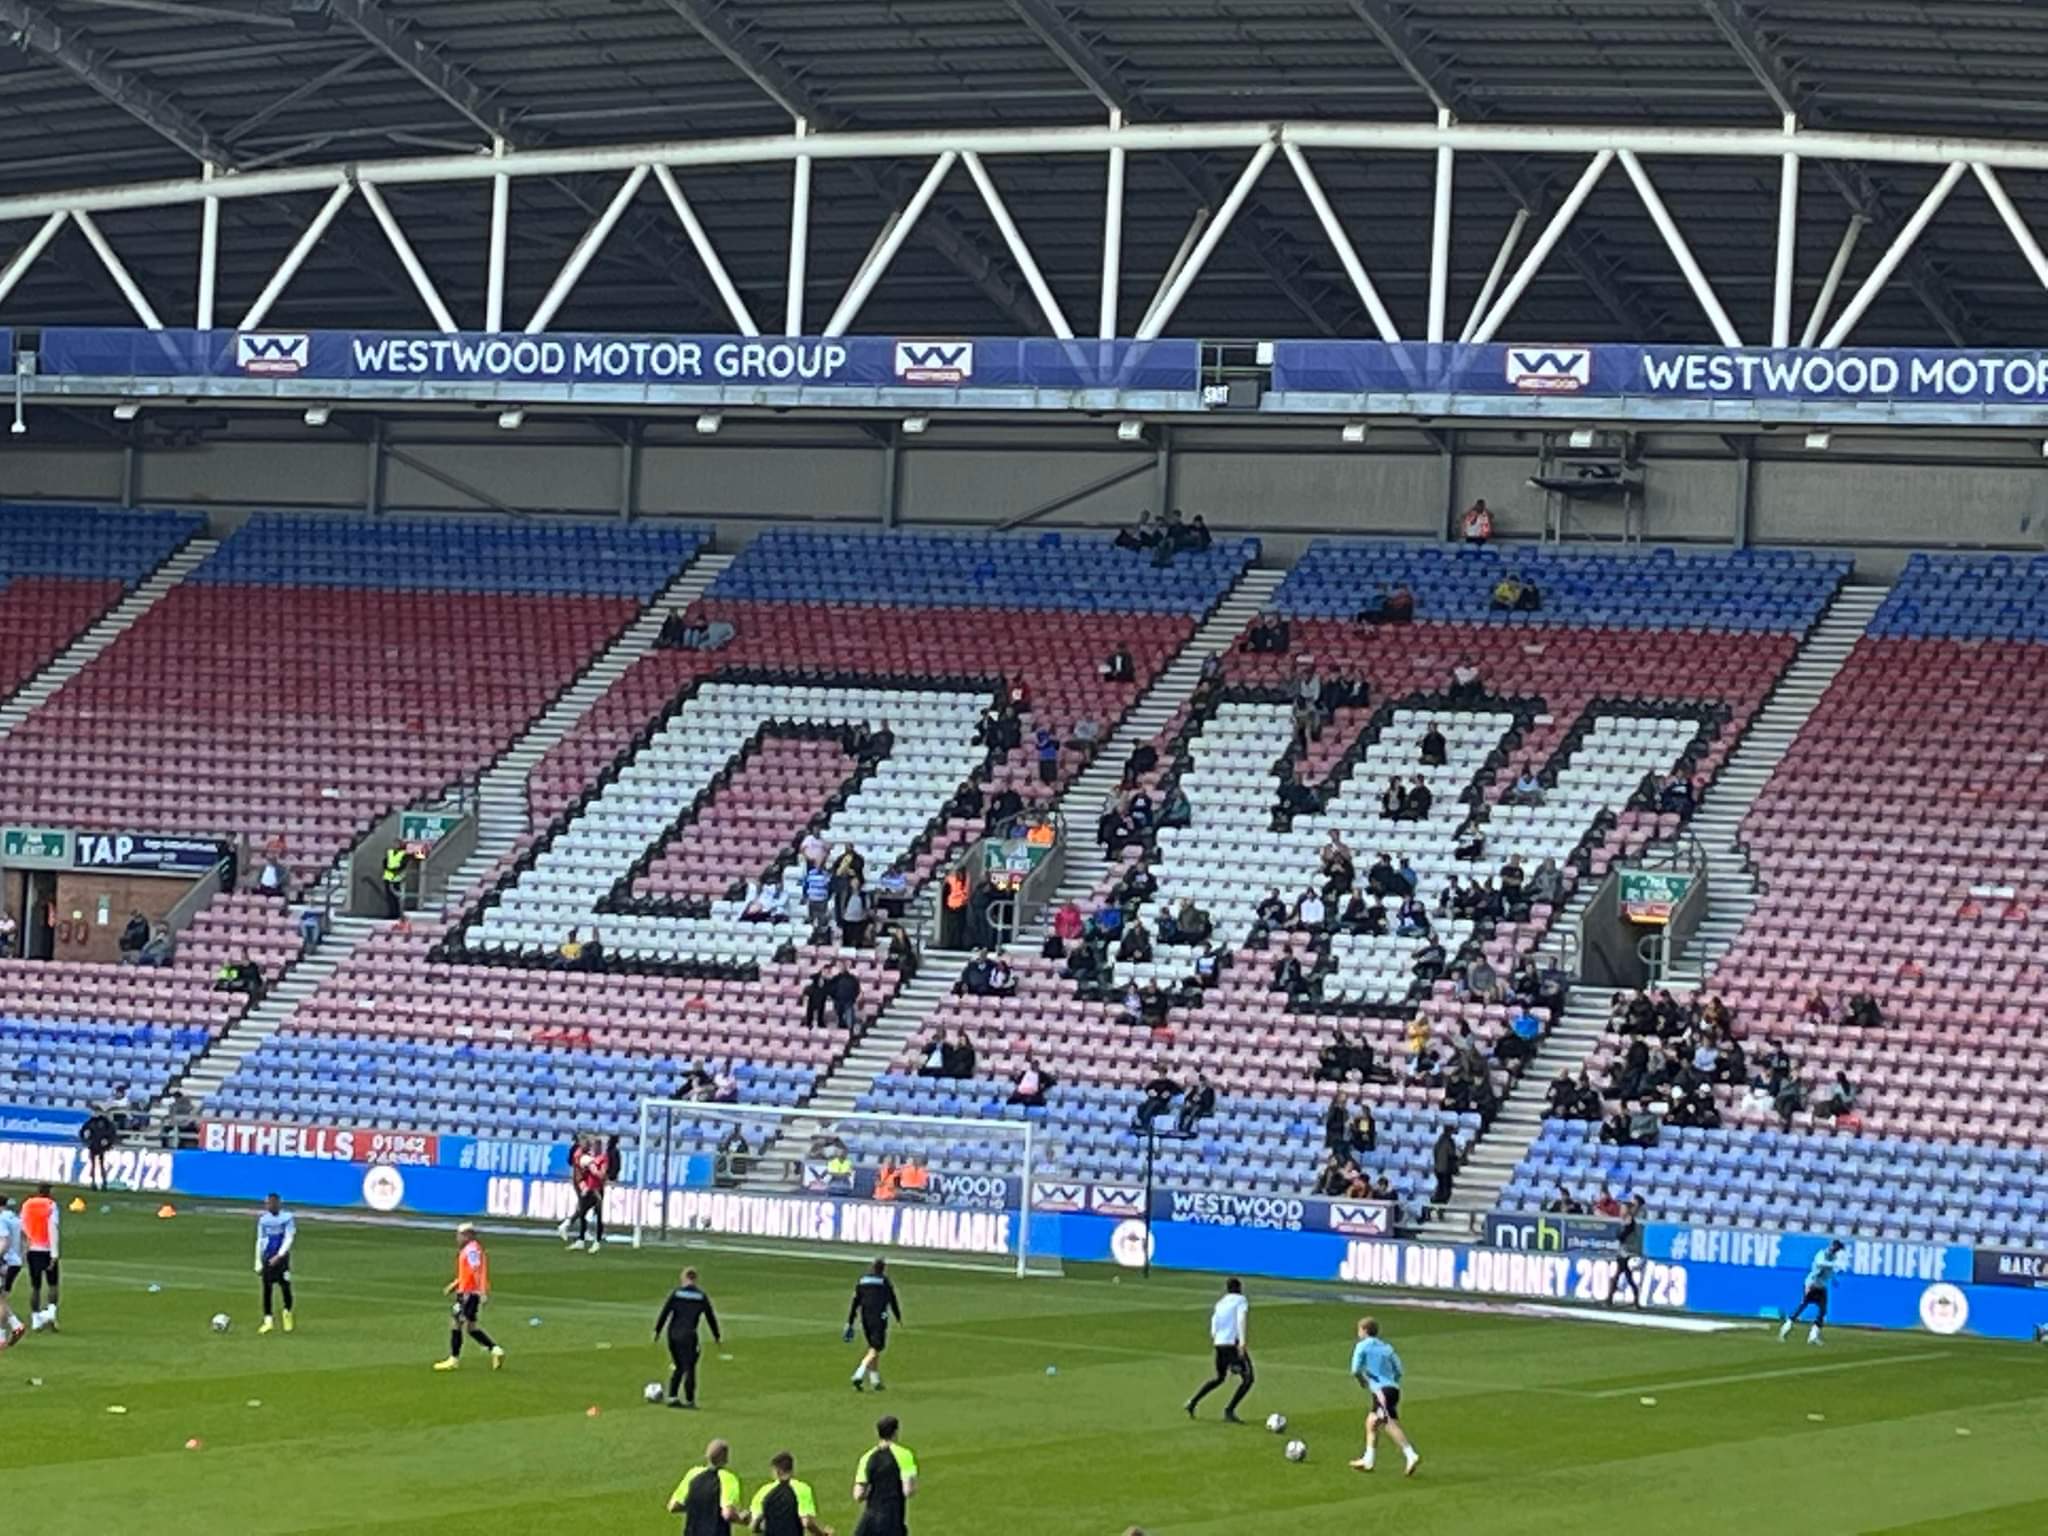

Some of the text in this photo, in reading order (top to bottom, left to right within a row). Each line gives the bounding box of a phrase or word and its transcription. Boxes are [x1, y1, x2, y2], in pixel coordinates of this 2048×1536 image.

[353, 339, 847, 378] WESTWOOD MOTOR GROUP
[1643, 355, 1900, 393] WESTWOOD
[77, 835, 134, 865] TAP
[204, 1122, 355, 1162] BITHELLS
[487, 1176, 524, 1217] LED
[668, 1190, 835, 1241] OPPORTUNITIES
[840, 1203, 895, 1245] NOW
[897, 1207, 1010, 1253] AVAILABLE
[1172, 1191, 1304, 1221] WESTWOOD
[1495, 1217, 1560, 1251] nrh
[1340, 1240, 1398, 1285] JOIN
[1405, 1245, 1456, 1289] OUR
[1461, 1249, 1571, 1298] JOURNEY
